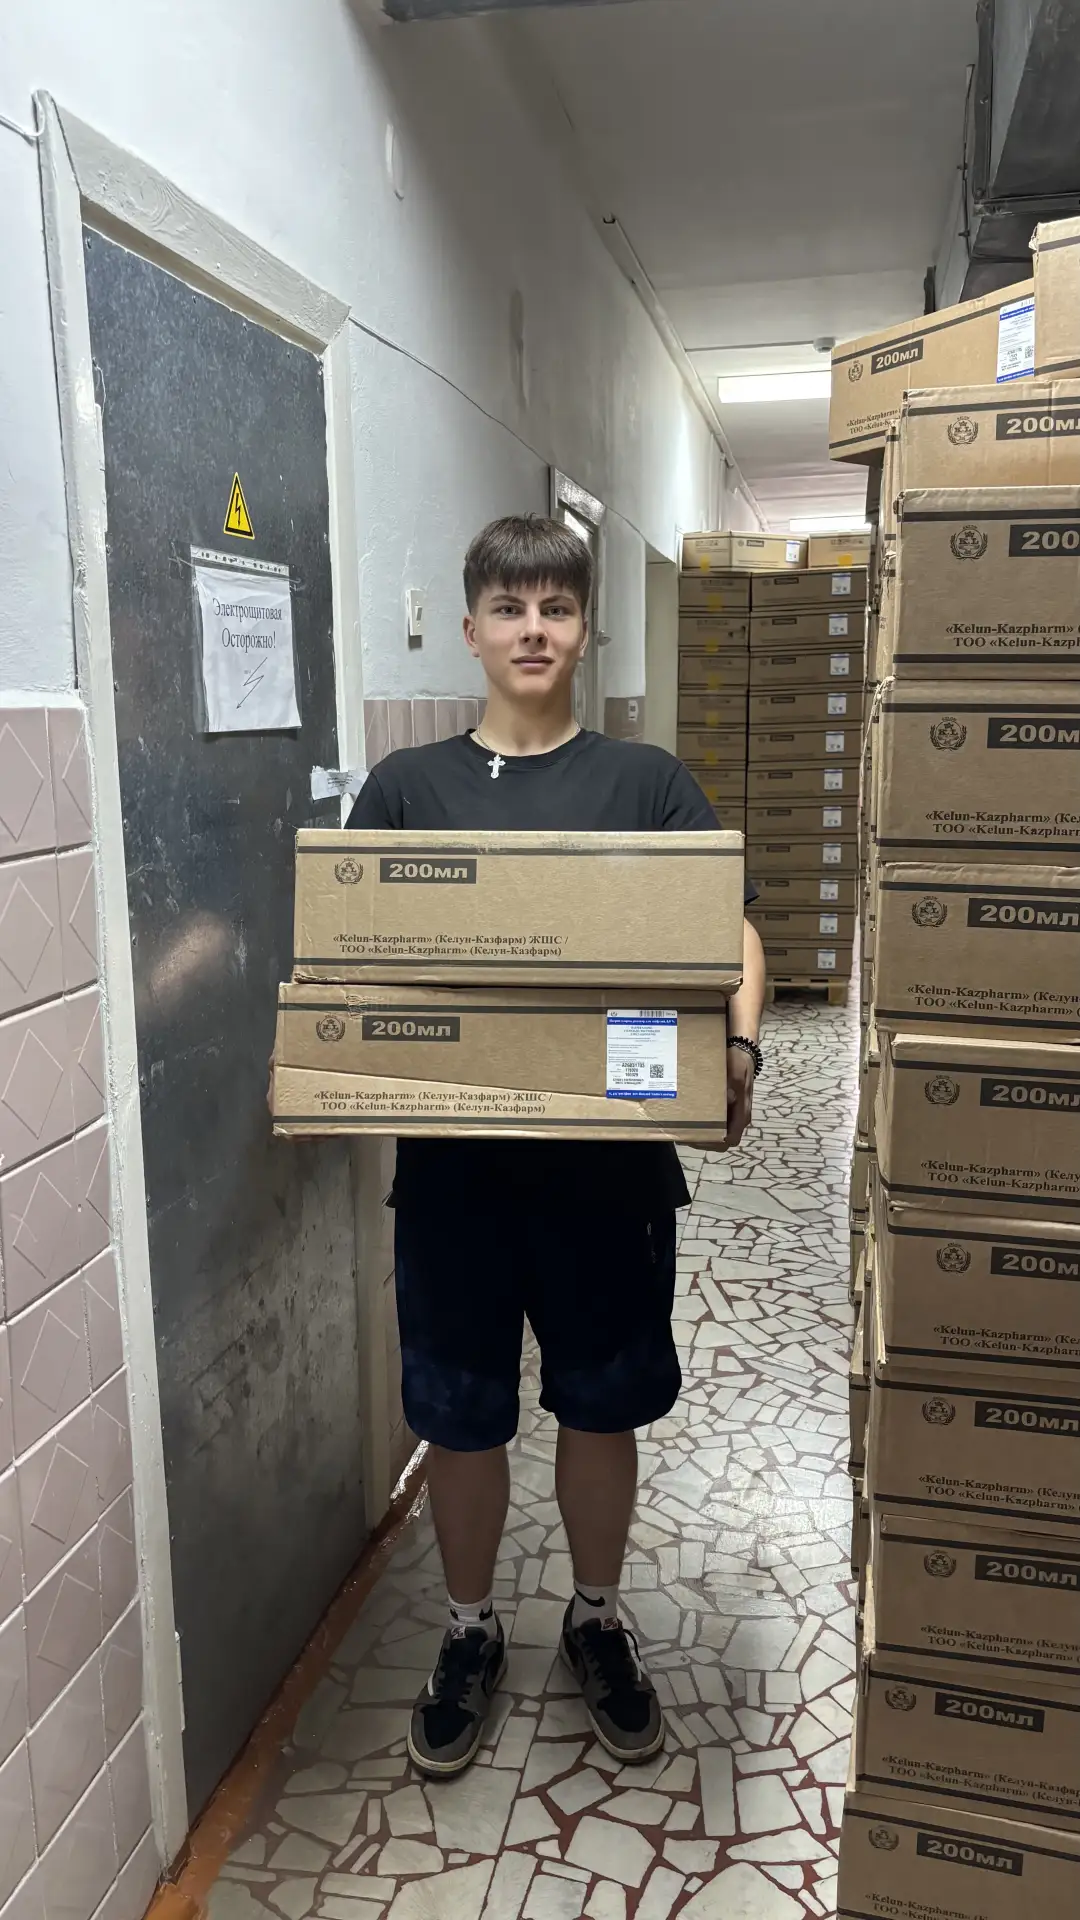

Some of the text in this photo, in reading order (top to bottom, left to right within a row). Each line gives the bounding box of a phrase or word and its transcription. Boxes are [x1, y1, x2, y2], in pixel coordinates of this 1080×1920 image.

[876, 347, 918, 369] 200мл
[212, 598, 282, 622] Электрощитовая
[945, 623, 1073, 636] «Kelun-Kazpharm»
[222, 628, 276, 653] Осторожно!
[954, 637, 986, 648] ТОО
[925, 810, 1050, 824] «Kelun-Kazpharm»
[933, 823, 965, 834] ТОО
[389, 863, 468, 879] 200мл
[979, 904, 1080, 926] 200мл
[333, 934, 433, 945] «Kelun-Kazpharm»
[435, 934, 527, 946] (Келун-Казфарм)
[529, 935, 563, 944] ЖШС
[340, 944, 562, 957] ТОО «Kelun-Kazpharm» (Келун-Казфарм)
[908, 984, 1029, 1000] «Kelun-Kazpharm»
[915, 996, 945, 1007] ТОО
[950, 999, 1072, 1015] «Kelun-Kazpharm»
[372, 1020, 451, 1037] 200мл
[314, 1091, 415, 1101] «Kelun-Kazpharm»
[418, 1091, 510, 1102] (Келун-Казфарм)
[513, 1093, 547, 1102] ЖШС
[321, 1101, 546, 1114] ТОО «Kelun-Kazpharm» (Келун-Казфарм)
[920, 1160, 1040, 1177] «Kelun-Kazpharm»
[928, 1172, 958, 1183] ТОО
[933, 1324, 1051, 1343] «Kelun-Kazpharm»
[940, 1336, 971, 1347] ТОО
[986, 1407, 1080, 1431] 200мл
[918, 1474, 1035, 1495] «Kelun-Kazpharm»
[926, 1485, 955, 1496] ТОО
[958, 1489, 1075, 1511] «Kelun-Kazpharm»
[986, 1561, 1078, 1586] 200мл
[921, 1624, 1033, 1645] «Kelun-Kazpharm»
[928, 1636, 957, 1647] ТОО
[959, 1640, 1073, 1662] «Kelun-Kazpharm»
[945, 1700, 1034, 1727] 200мл
[882, 1755, 990, 1780] «Kelun-Kazpharm»
[889, 1766, 916, 1778] ТОО
[920, 1770, 1029, 1796] «Kelun-Kazpharm»
[927, 1839, 1013, 1869] 200мл
[873, 1903, 899, 1915] ТОО
